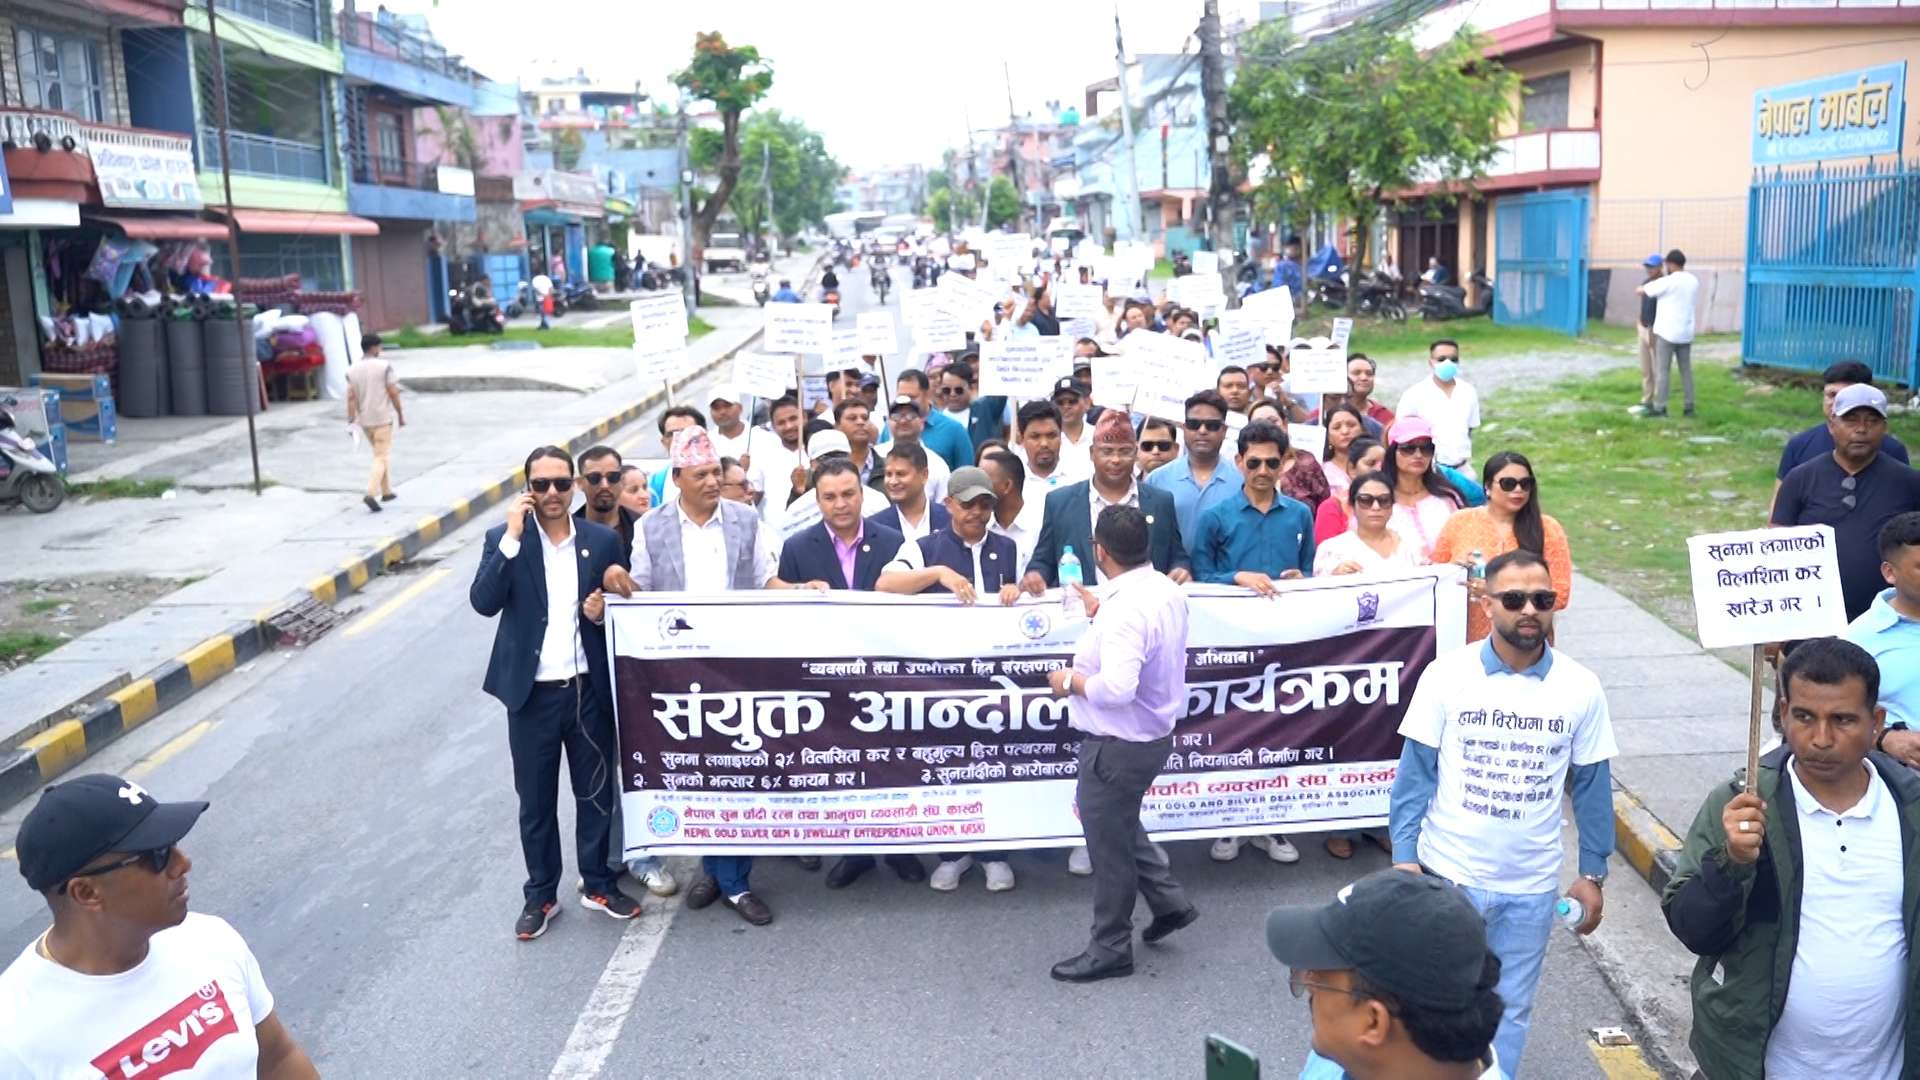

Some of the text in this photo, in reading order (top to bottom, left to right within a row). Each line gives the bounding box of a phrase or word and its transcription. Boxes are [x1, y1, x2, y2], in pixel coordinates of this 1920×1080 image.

[1758, 77, 1894, 140] नेपाल मार्बल
[1707, 531, 1825, 561] सुनमा लगाएको
[1717, 565, 1823, 588] विलाशिता कर
[1725, 597, 1773, 618] खारेज
[1780, 597, 1802, 612] गर
[873, 661, 899, 675] तथा
[651, 682, 831, 751] संयुक्त
[848, 675, 1074, 734] आन्दोल
[1458, 708, 1487, 726] हामी
[1492, 709, 1543, 732] विरोधमा
[660, 752, 700, 769] सुनमा
[801, 747, 860, 765] विलासिता
[866, 748, 890, 761] कर
[896, 747, 906, 761] र
[1182, 734, 1202, 747] गर
[1188, 748, 1254, 768] नियमावली
[1258, 747, 1299, 764] निर्माण
[1305, 748, 1325, 760] गर
[660, 772, 703, 791] सुनको
[708, 774, 755, 788] भन्सार
[788, 772, 829, 788] कायम
[835, 772, 856, 786] गर
[1208, 775, 1289, 793] व्यवसायी
[1296, 774, 1328, 788] संघ
[683, 806, 715, 820] नेपाल
[946, 800, 983, 814] कास्की
[1200, 799, 1223, 808] AND
[1227, 795, 1266, 806] SILVER
[683, 828, 712, 838] NEPAL
[714, 828, 738, 838] GOLD
[741, 828, 769, 838] SILVER
[772, 828, 791, 838] GEM
[118, 1001, 225, 1079] Levi's
